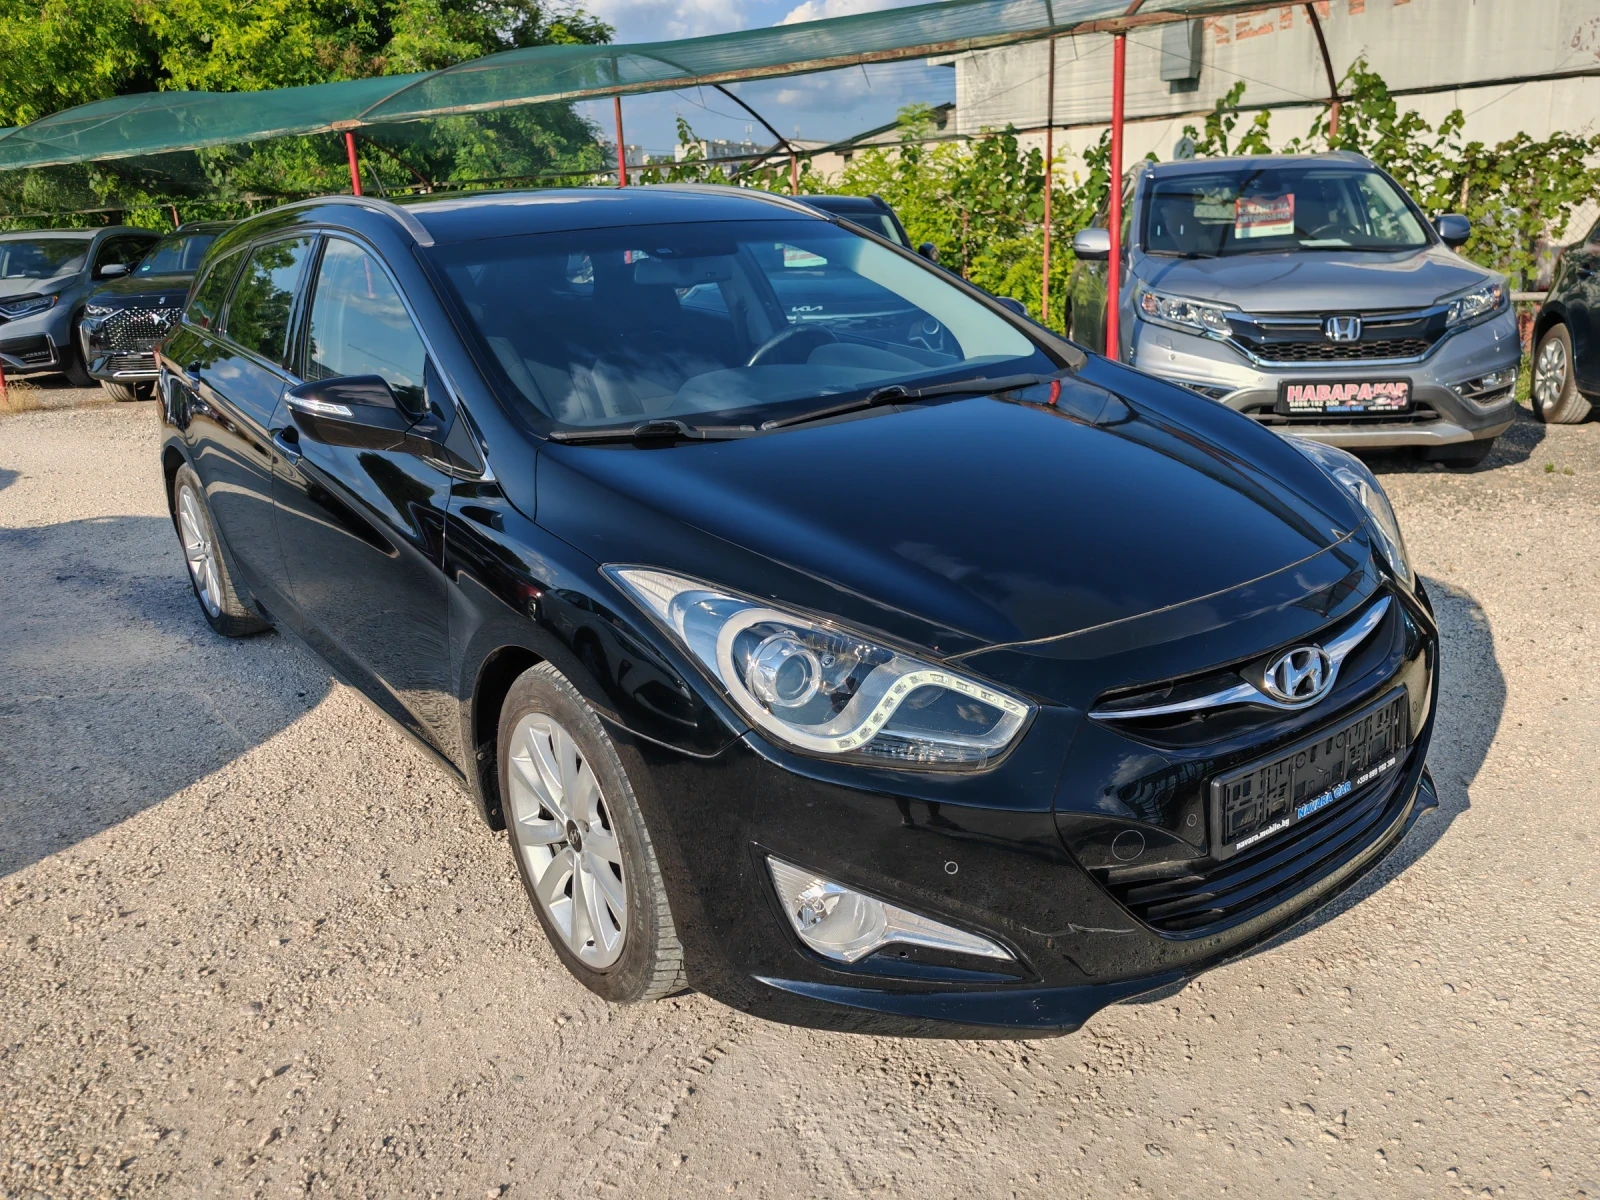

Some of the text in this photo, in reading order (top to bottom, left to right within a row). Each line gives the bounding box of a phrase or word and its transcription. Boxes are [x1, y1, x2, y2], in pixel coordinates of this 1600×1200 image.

[1238, 202, 1290, 215] КРЕДИТ ЗА
[1287, 383, 1373, 402] НАВАРА
[1236, 818, 1290, 850] navara.mobile.bg
[1333, 780, 1351, 798] CAR
